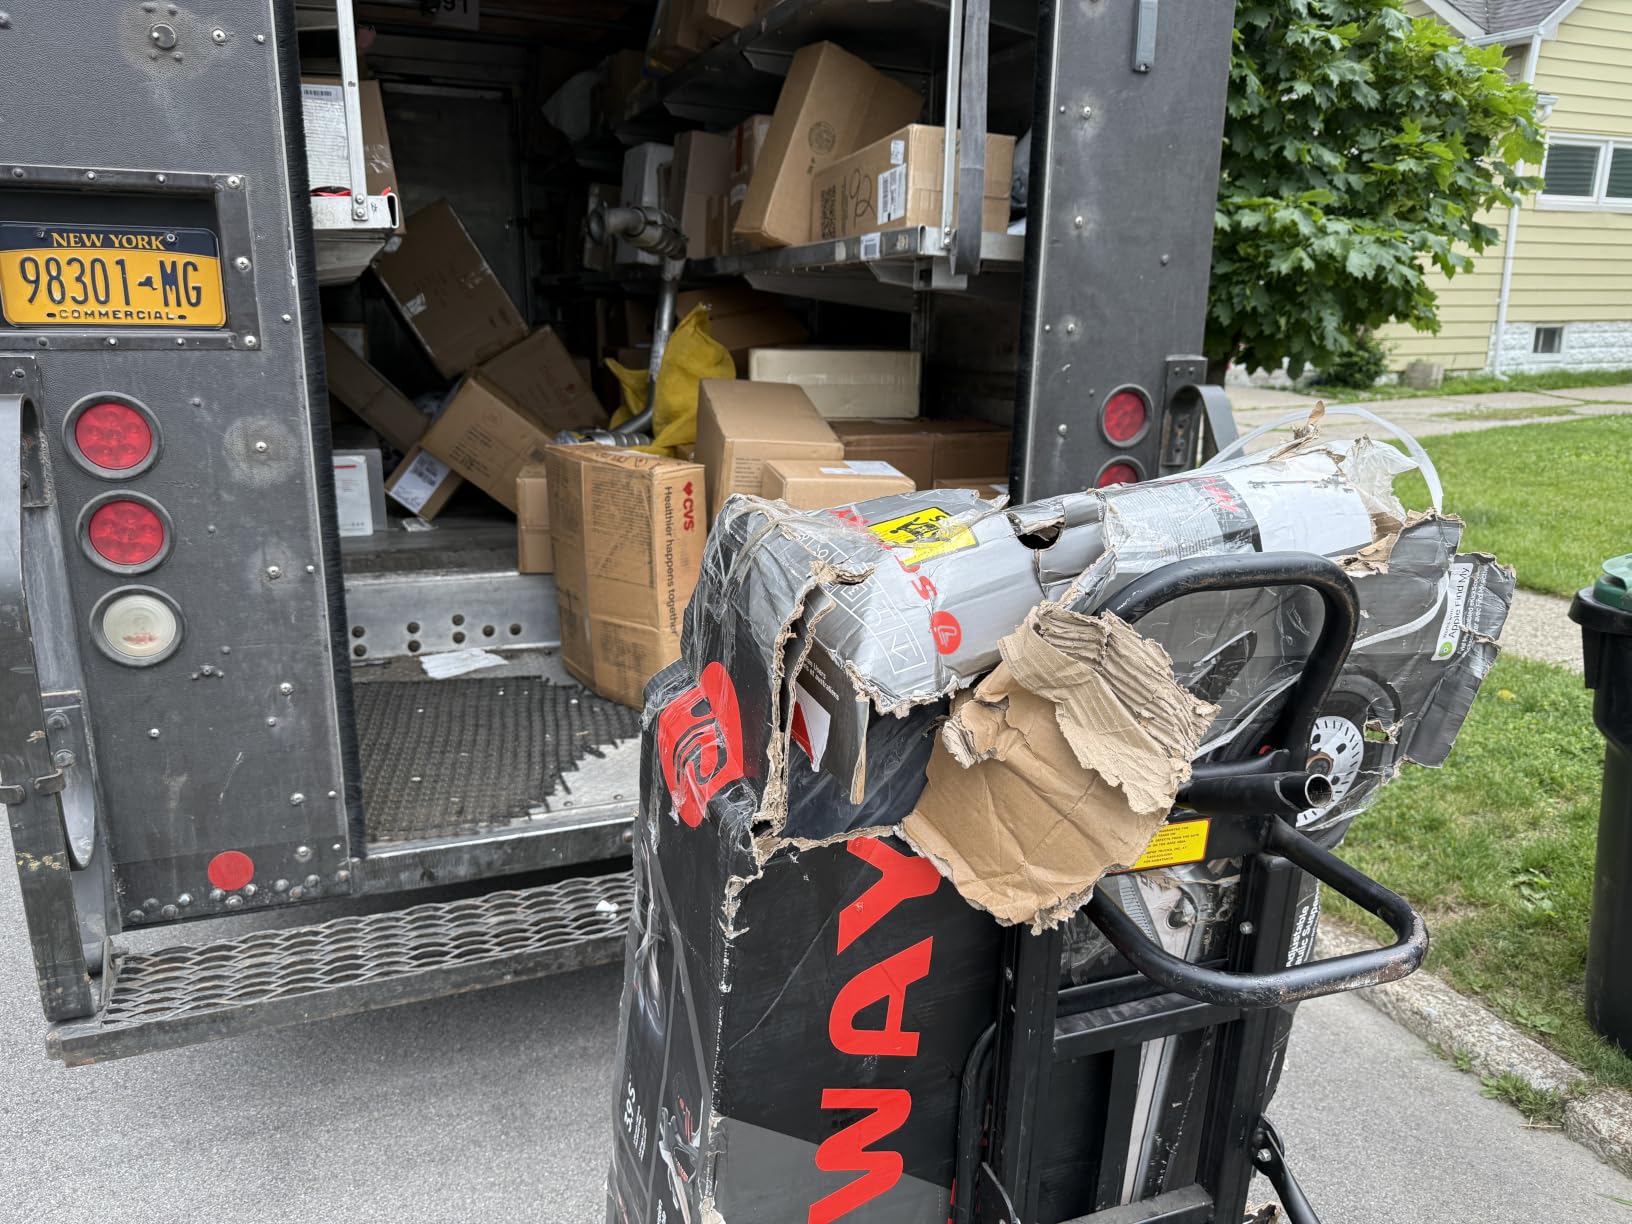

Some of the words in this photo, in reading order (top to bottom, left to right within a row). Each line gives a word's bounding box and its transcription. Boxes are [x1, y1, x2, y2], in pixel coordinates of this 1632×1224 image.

[51, 232, 104, 248] NEW
[109, 234, 167, 250] YORK
[20, 256, 131, 306] 98301
[159, 259, 202, 307] MG
[60, 309, 175, 321] COMMERCIAL
[664, 486, 674, 537] Healthier
[682, 499, 695, 531] CVS
[664, 538, 675, 590] happens
[1459, 567, 1470, 583] My
[666, 589, 678, 634] together
[1455, 585, 1464, 607] Find
[1449, 609, 1461, 639] Apple
[1286, 906, 1309, 967] Adjustable
[1295, 938, 1308, 966] aulic
[808, 836, 941, 1224] WAY
